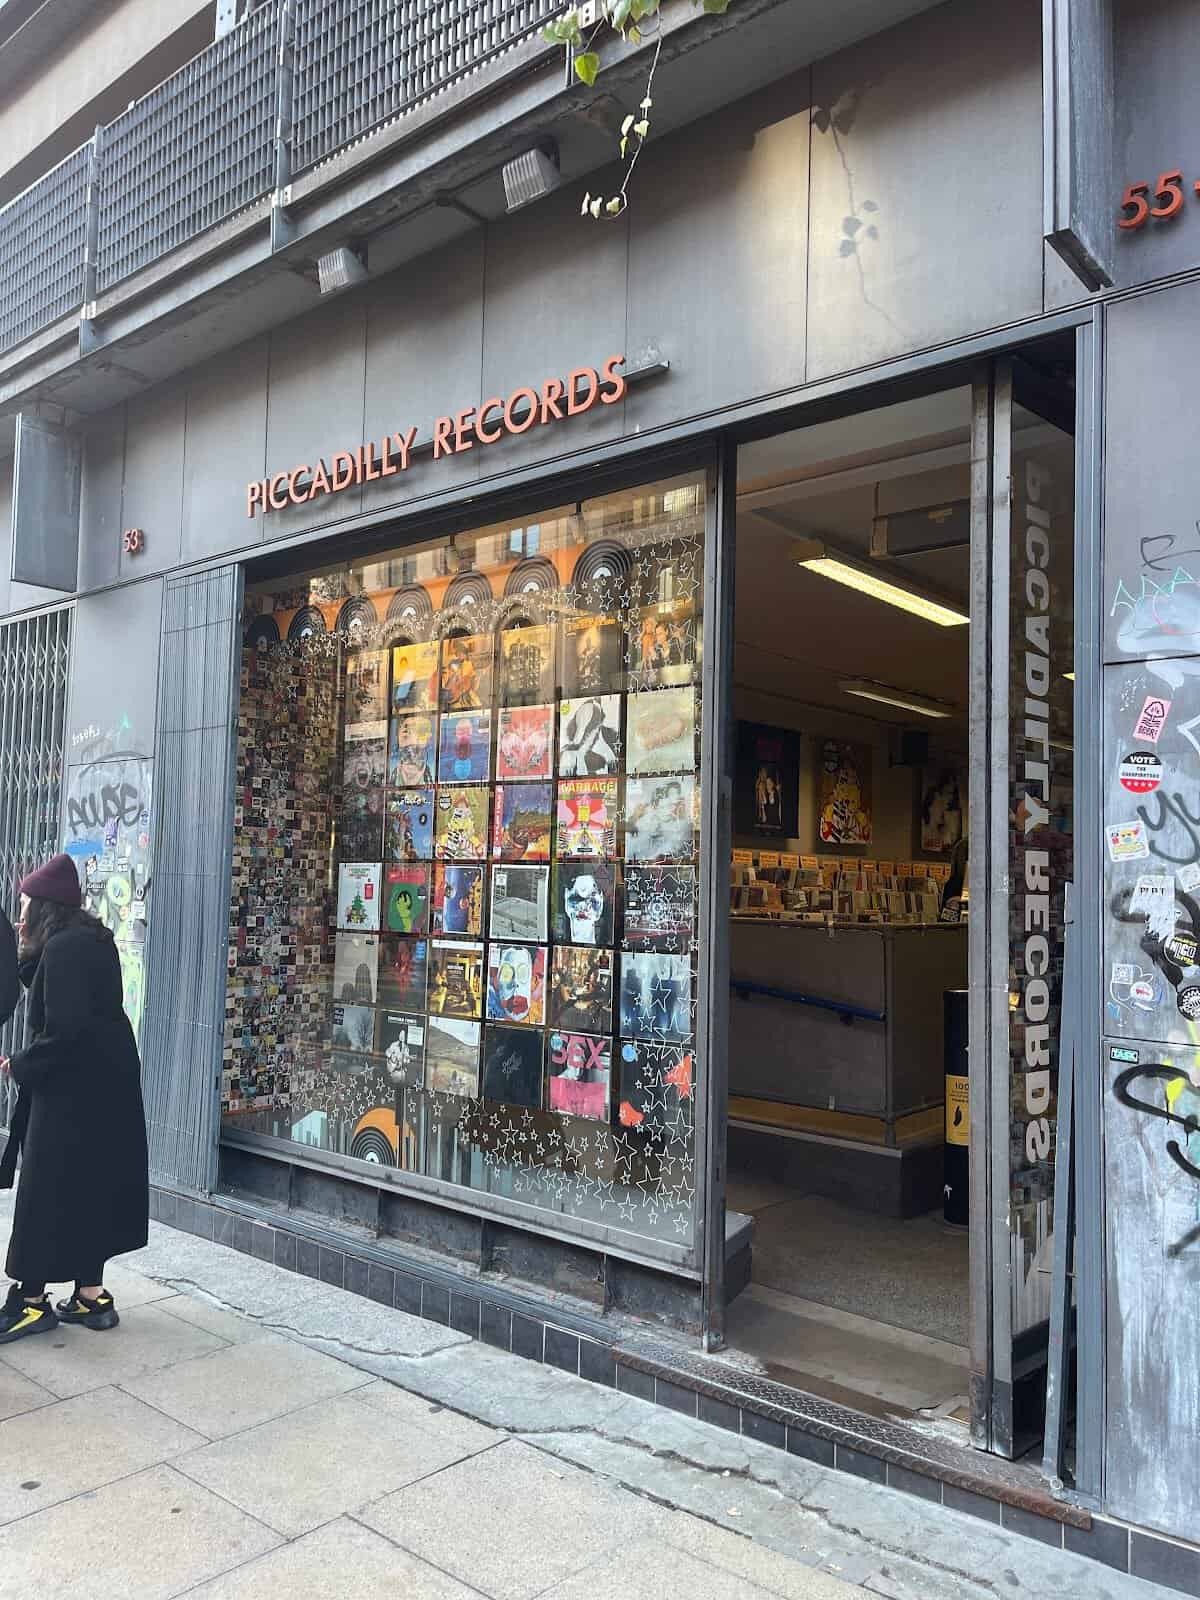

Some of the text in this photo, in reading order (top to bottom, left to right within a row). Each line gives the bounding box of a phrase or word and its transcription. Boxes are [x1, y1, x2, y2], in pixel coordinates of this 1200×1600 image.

[247, 354, 626, 518] PICCADILLY RECORDS
[122, 528, 141, 552] 53
[1129, 755, 1156, 765] VOTE
[551, 1033, 606, 1071] SEX
